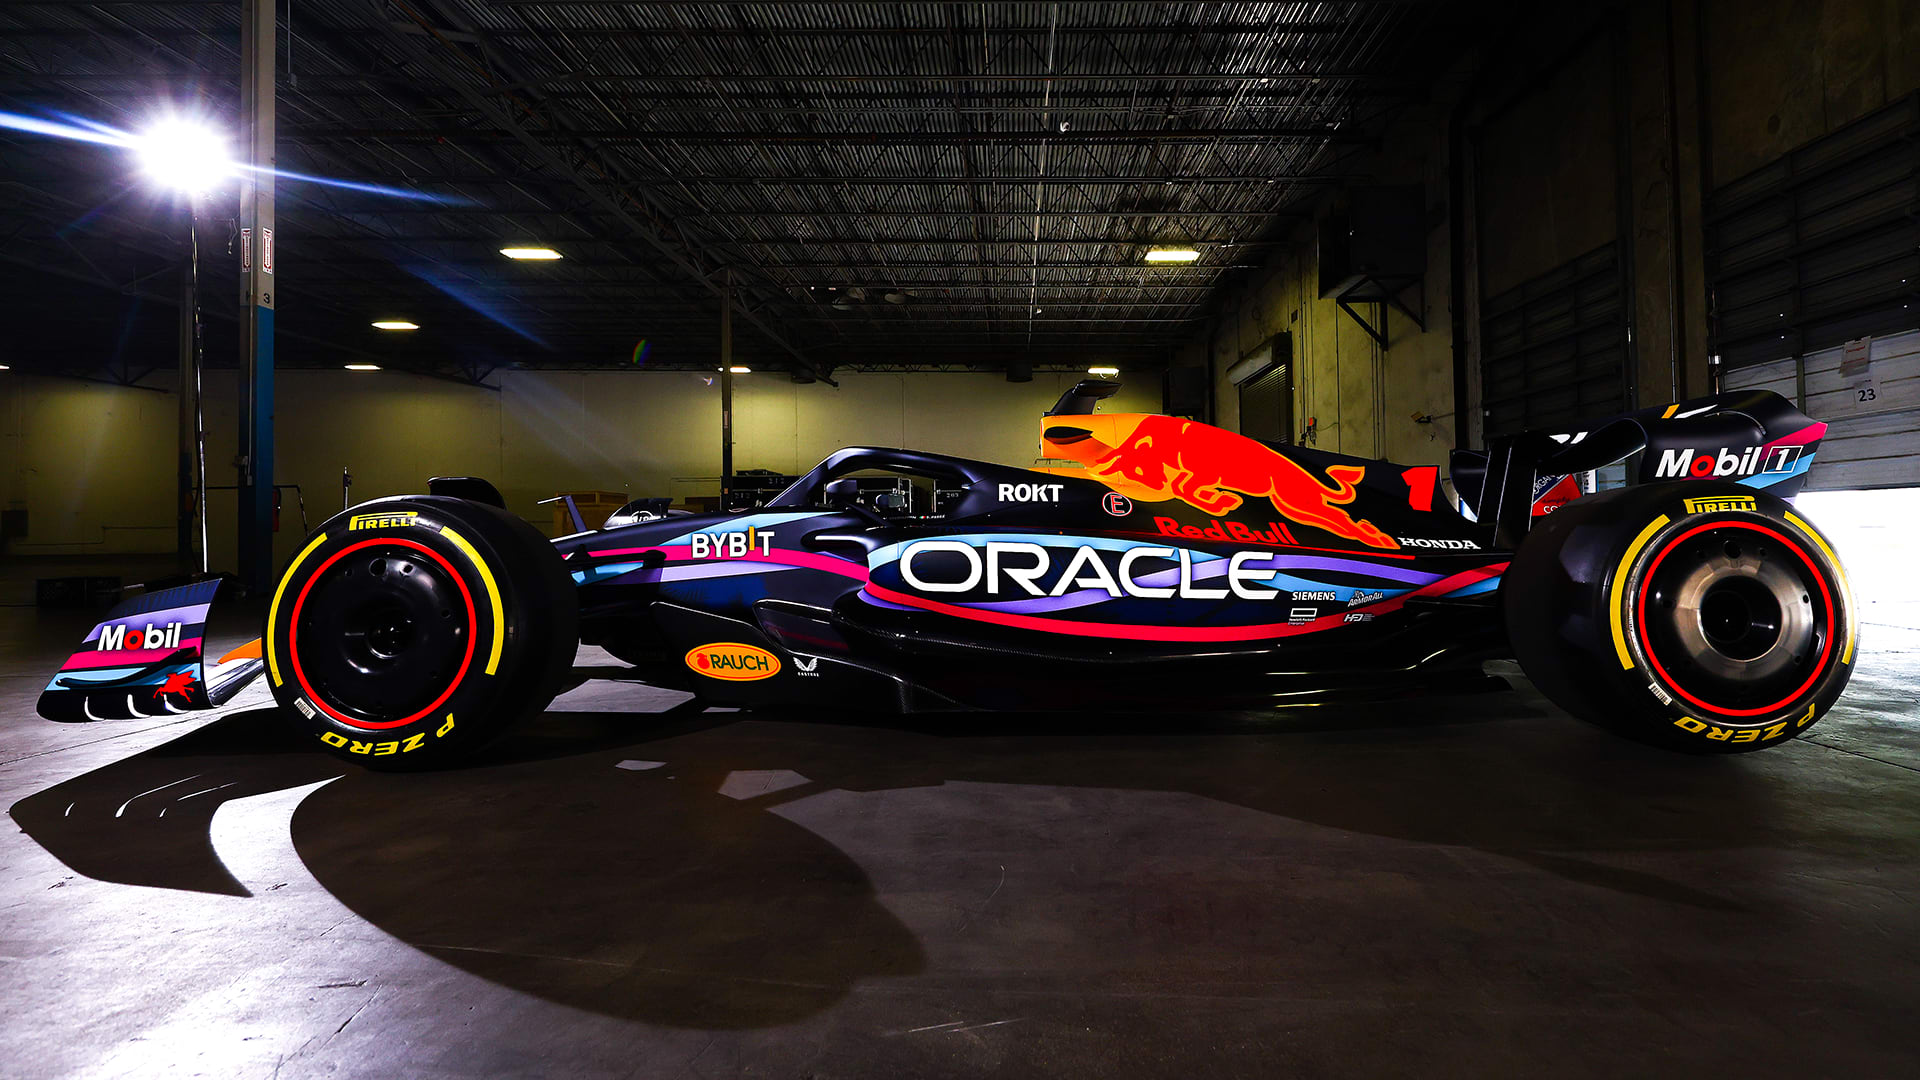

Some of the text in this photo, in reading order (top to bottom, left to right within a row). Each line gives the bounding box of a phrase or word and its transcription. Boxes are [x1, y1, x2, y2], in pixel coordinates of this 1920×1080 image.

[263, 292, 271, 304] 3
[1858, 388, 1876, 402] 23
[1655, 447, 1763, 478] Mobil
[998, 483, 1064, 502] ROKT
[1401, 466, 1438, 512] 1
[1110, 494, 1125, 514] E
[1683, 496, 1757, 514] PIRELLI
[348, 511, 418, 531] PIRELLI
[692, 526, 775, 558] BYBIT
[1397, 537, 1482, 549] HONDA
[900, 541, 1280, 600] ORACLE
[1292, 591, 1336, 601] SIEMENS
[97, 622, 182, 651] Mobil
[710, 654, 769, 671] RAUCH
[1673, 703, 1815, 743] P ZERO
[320, 713, 455, 756] P ZERO
